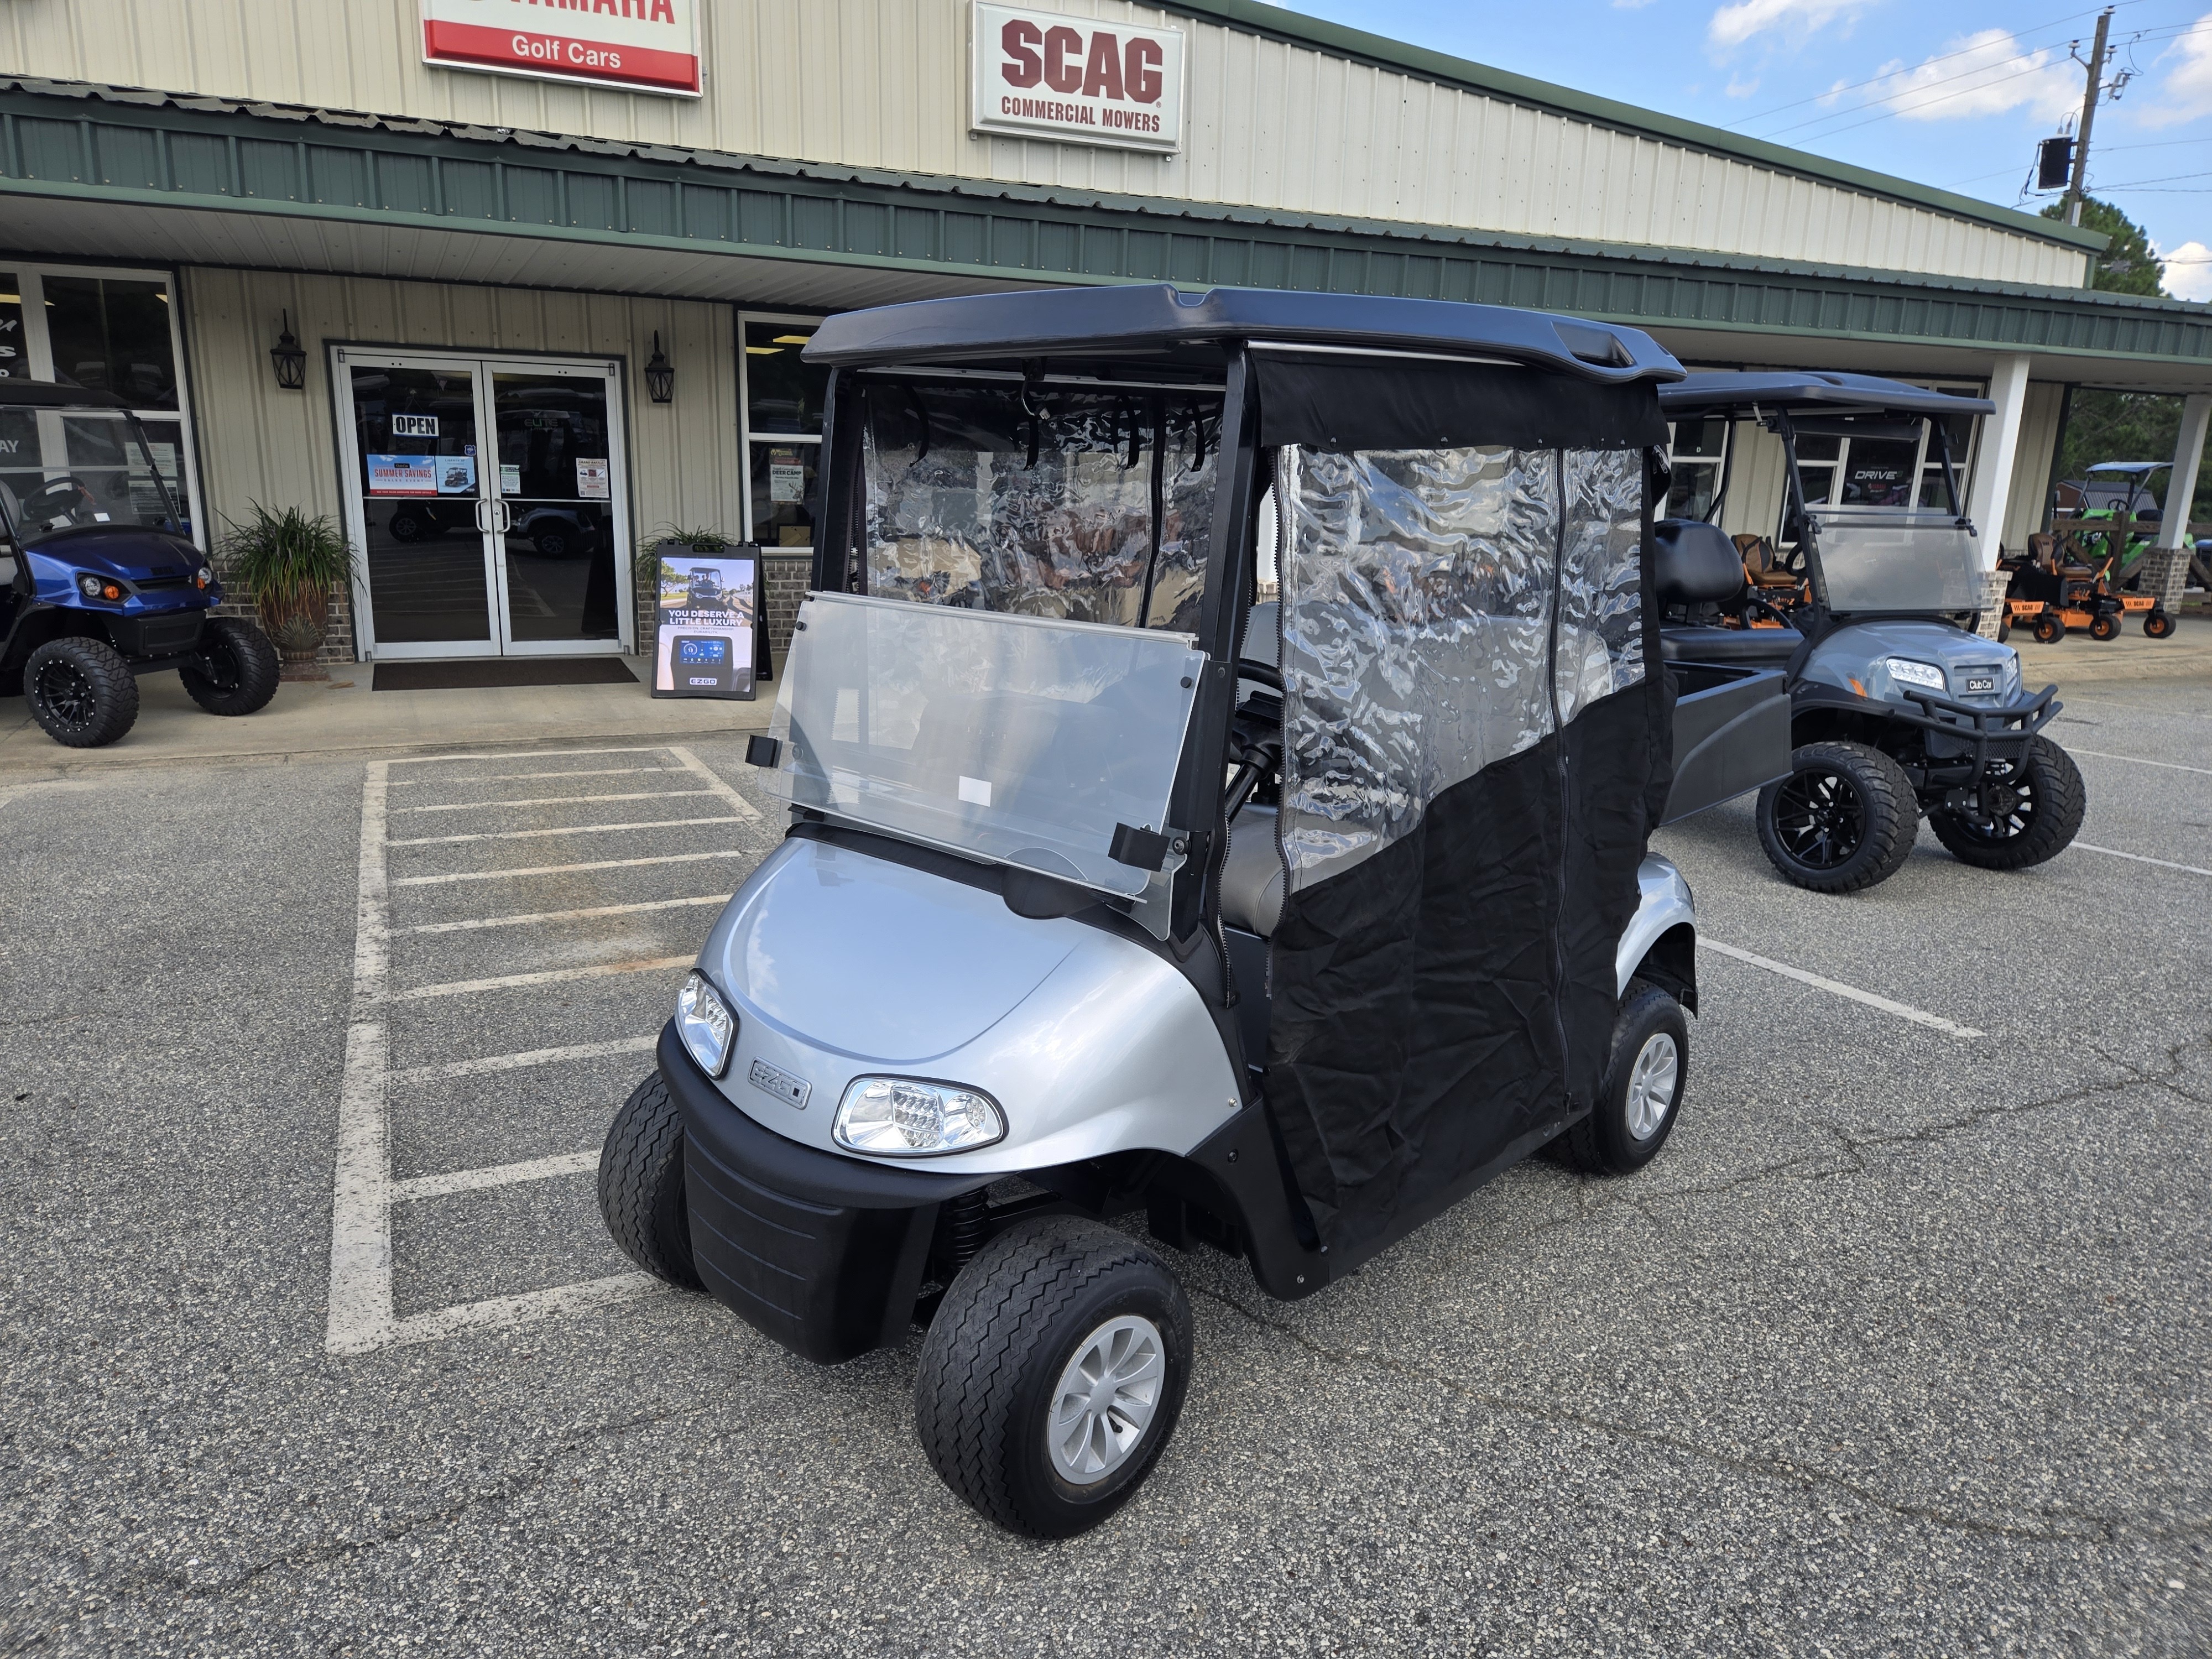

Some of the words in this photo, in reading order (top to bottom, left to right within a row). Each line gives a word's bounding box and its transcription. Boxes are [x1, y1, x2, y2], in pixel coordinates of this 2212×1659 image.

[512, 35, 560, 60] Golf
[568, 42, 621, 69] Cars
[1001, 19, 1163, 104] SCAG
[1001, 96, 1096, 126] COMMERCIAL
[1102, 108, 1161, 133] MOWERS
[395, 416, 436, 435] OPEN
[374, 469, 403, 478] SUMMER
[405, 469, 431, 478] SAVINGS
[1969, 680, 1983, 689] Club
[1983, 680, 1991, 688] Car
